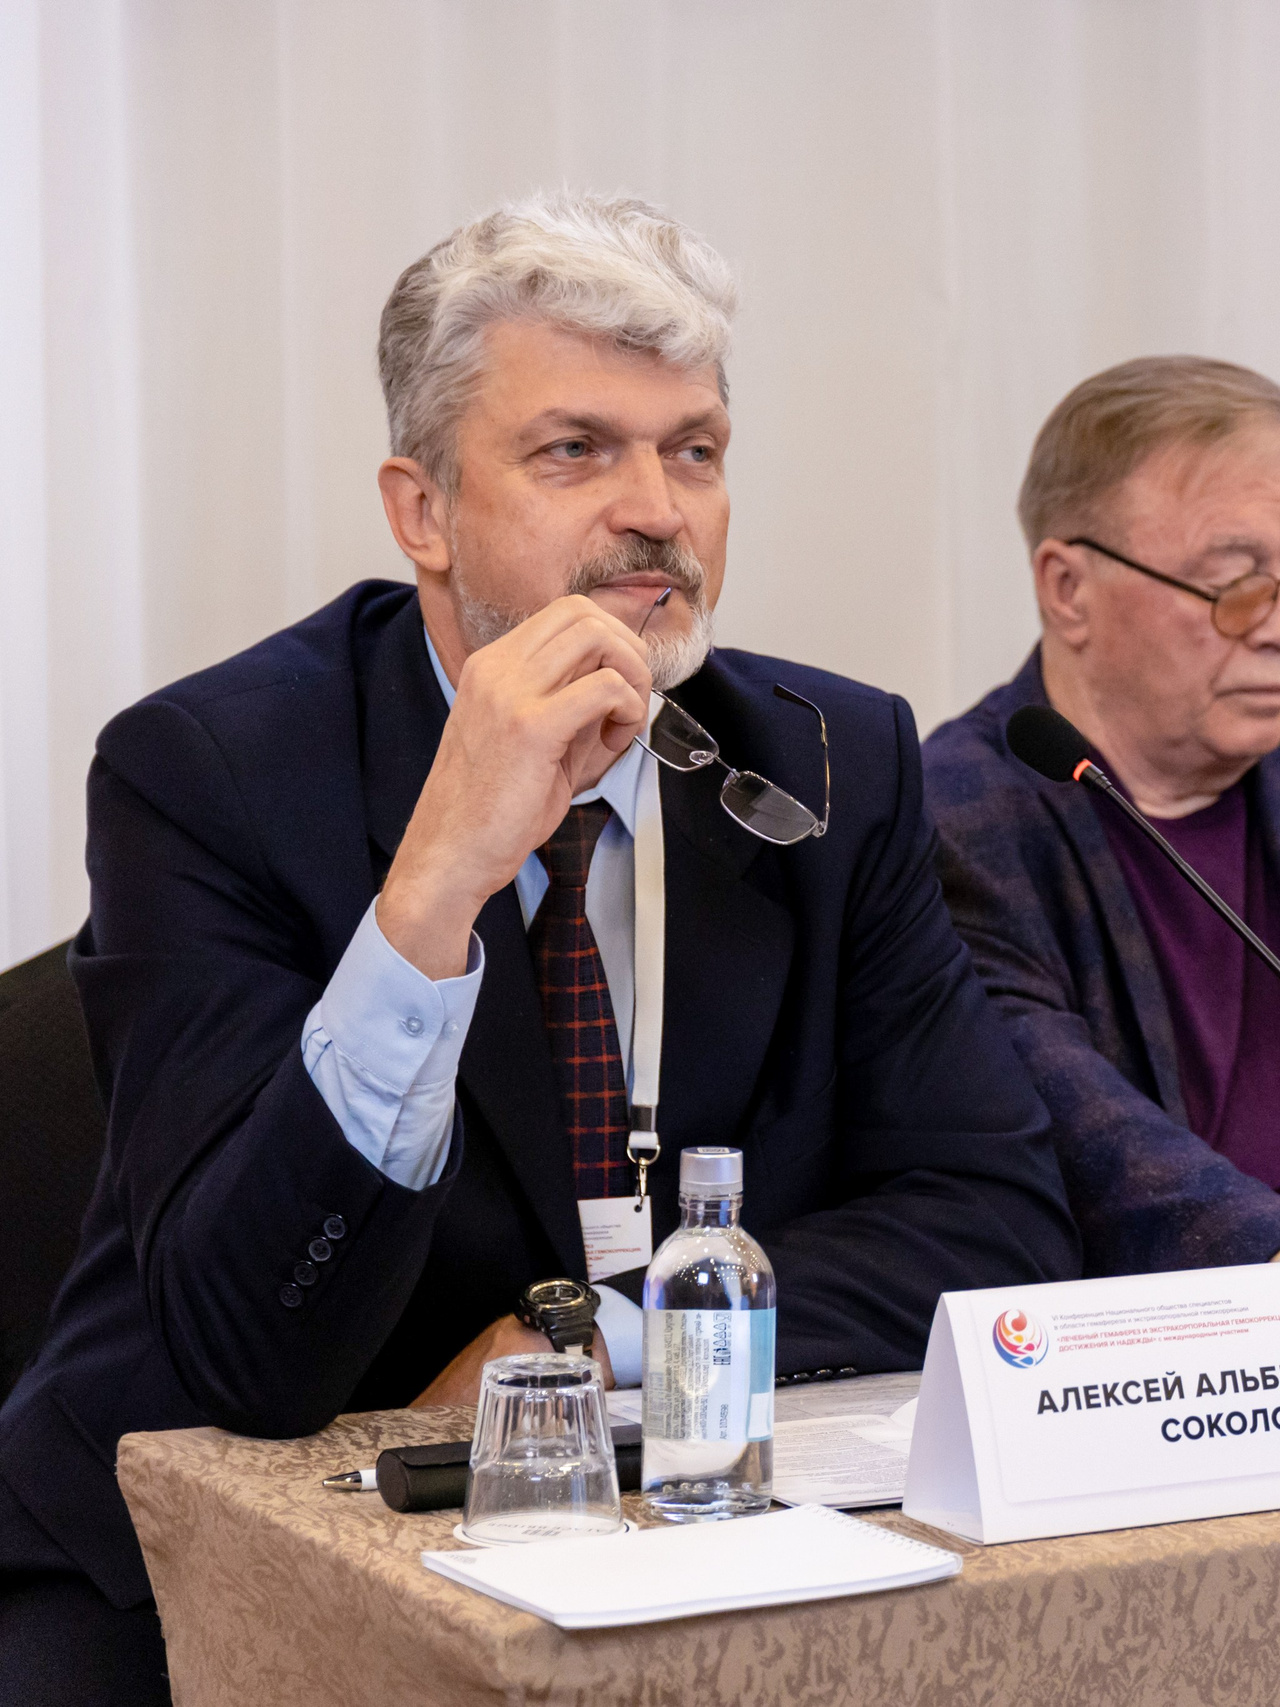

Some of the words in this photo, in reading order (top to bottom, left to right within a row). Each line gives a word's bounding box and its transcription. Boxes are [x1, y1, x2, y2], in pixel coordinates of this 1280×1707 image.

[1057, 1332, 1098, 1341] «ЛЕЧЕБНЫЙ
[1099, 1329, 1141, 1338] ГЕМАФЕРЕЗ
[1149, 1319, 1230, 1333] ЭКСТРАКОРПОРАЛЬНАЯ
[1058, 1340, 1108, 1352] ДОСТИЖЕНИЯ
[1116, 1337, 1156, 1345] НАДЕЖДЫ»
[1163, 1331, 1218, 1340] международным
[1219, 1328, 1249, 1336] участием
[1037, 1370, 1184, 1414] АЛЕКСЕЙ
